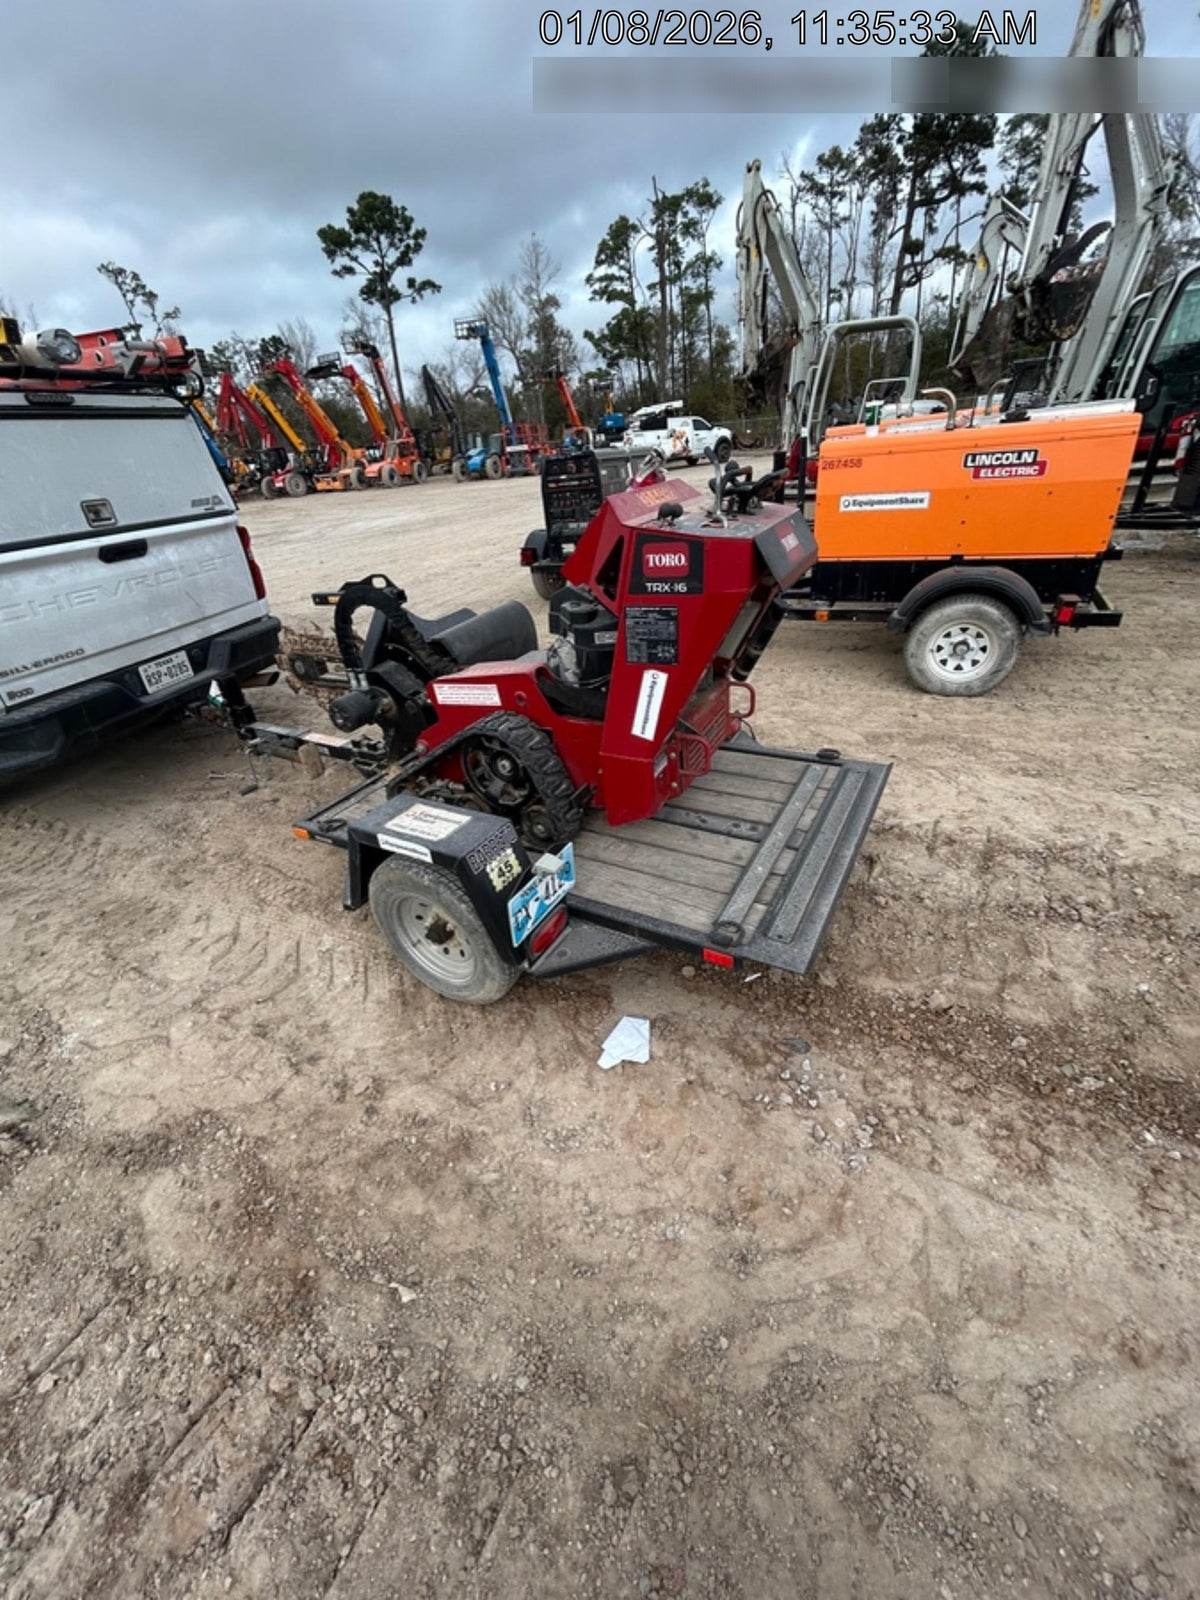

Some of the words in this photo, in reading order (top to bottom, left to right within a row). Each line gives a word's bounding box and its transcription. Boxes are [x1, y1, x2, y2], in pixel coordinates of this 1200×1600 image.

[965, 450, 1036, 467] LINCOLN
[978, 465, 1040, 478] ELECTRIC
[851, 496, 926, 508] EquipmentShare
[644, 553, 687, 568] TORO
[0, 553, 233, 622] CHEVROLET
[645, 582, 688, 593] TRX-16
[0, 648, 85, 678] SILVERADO
